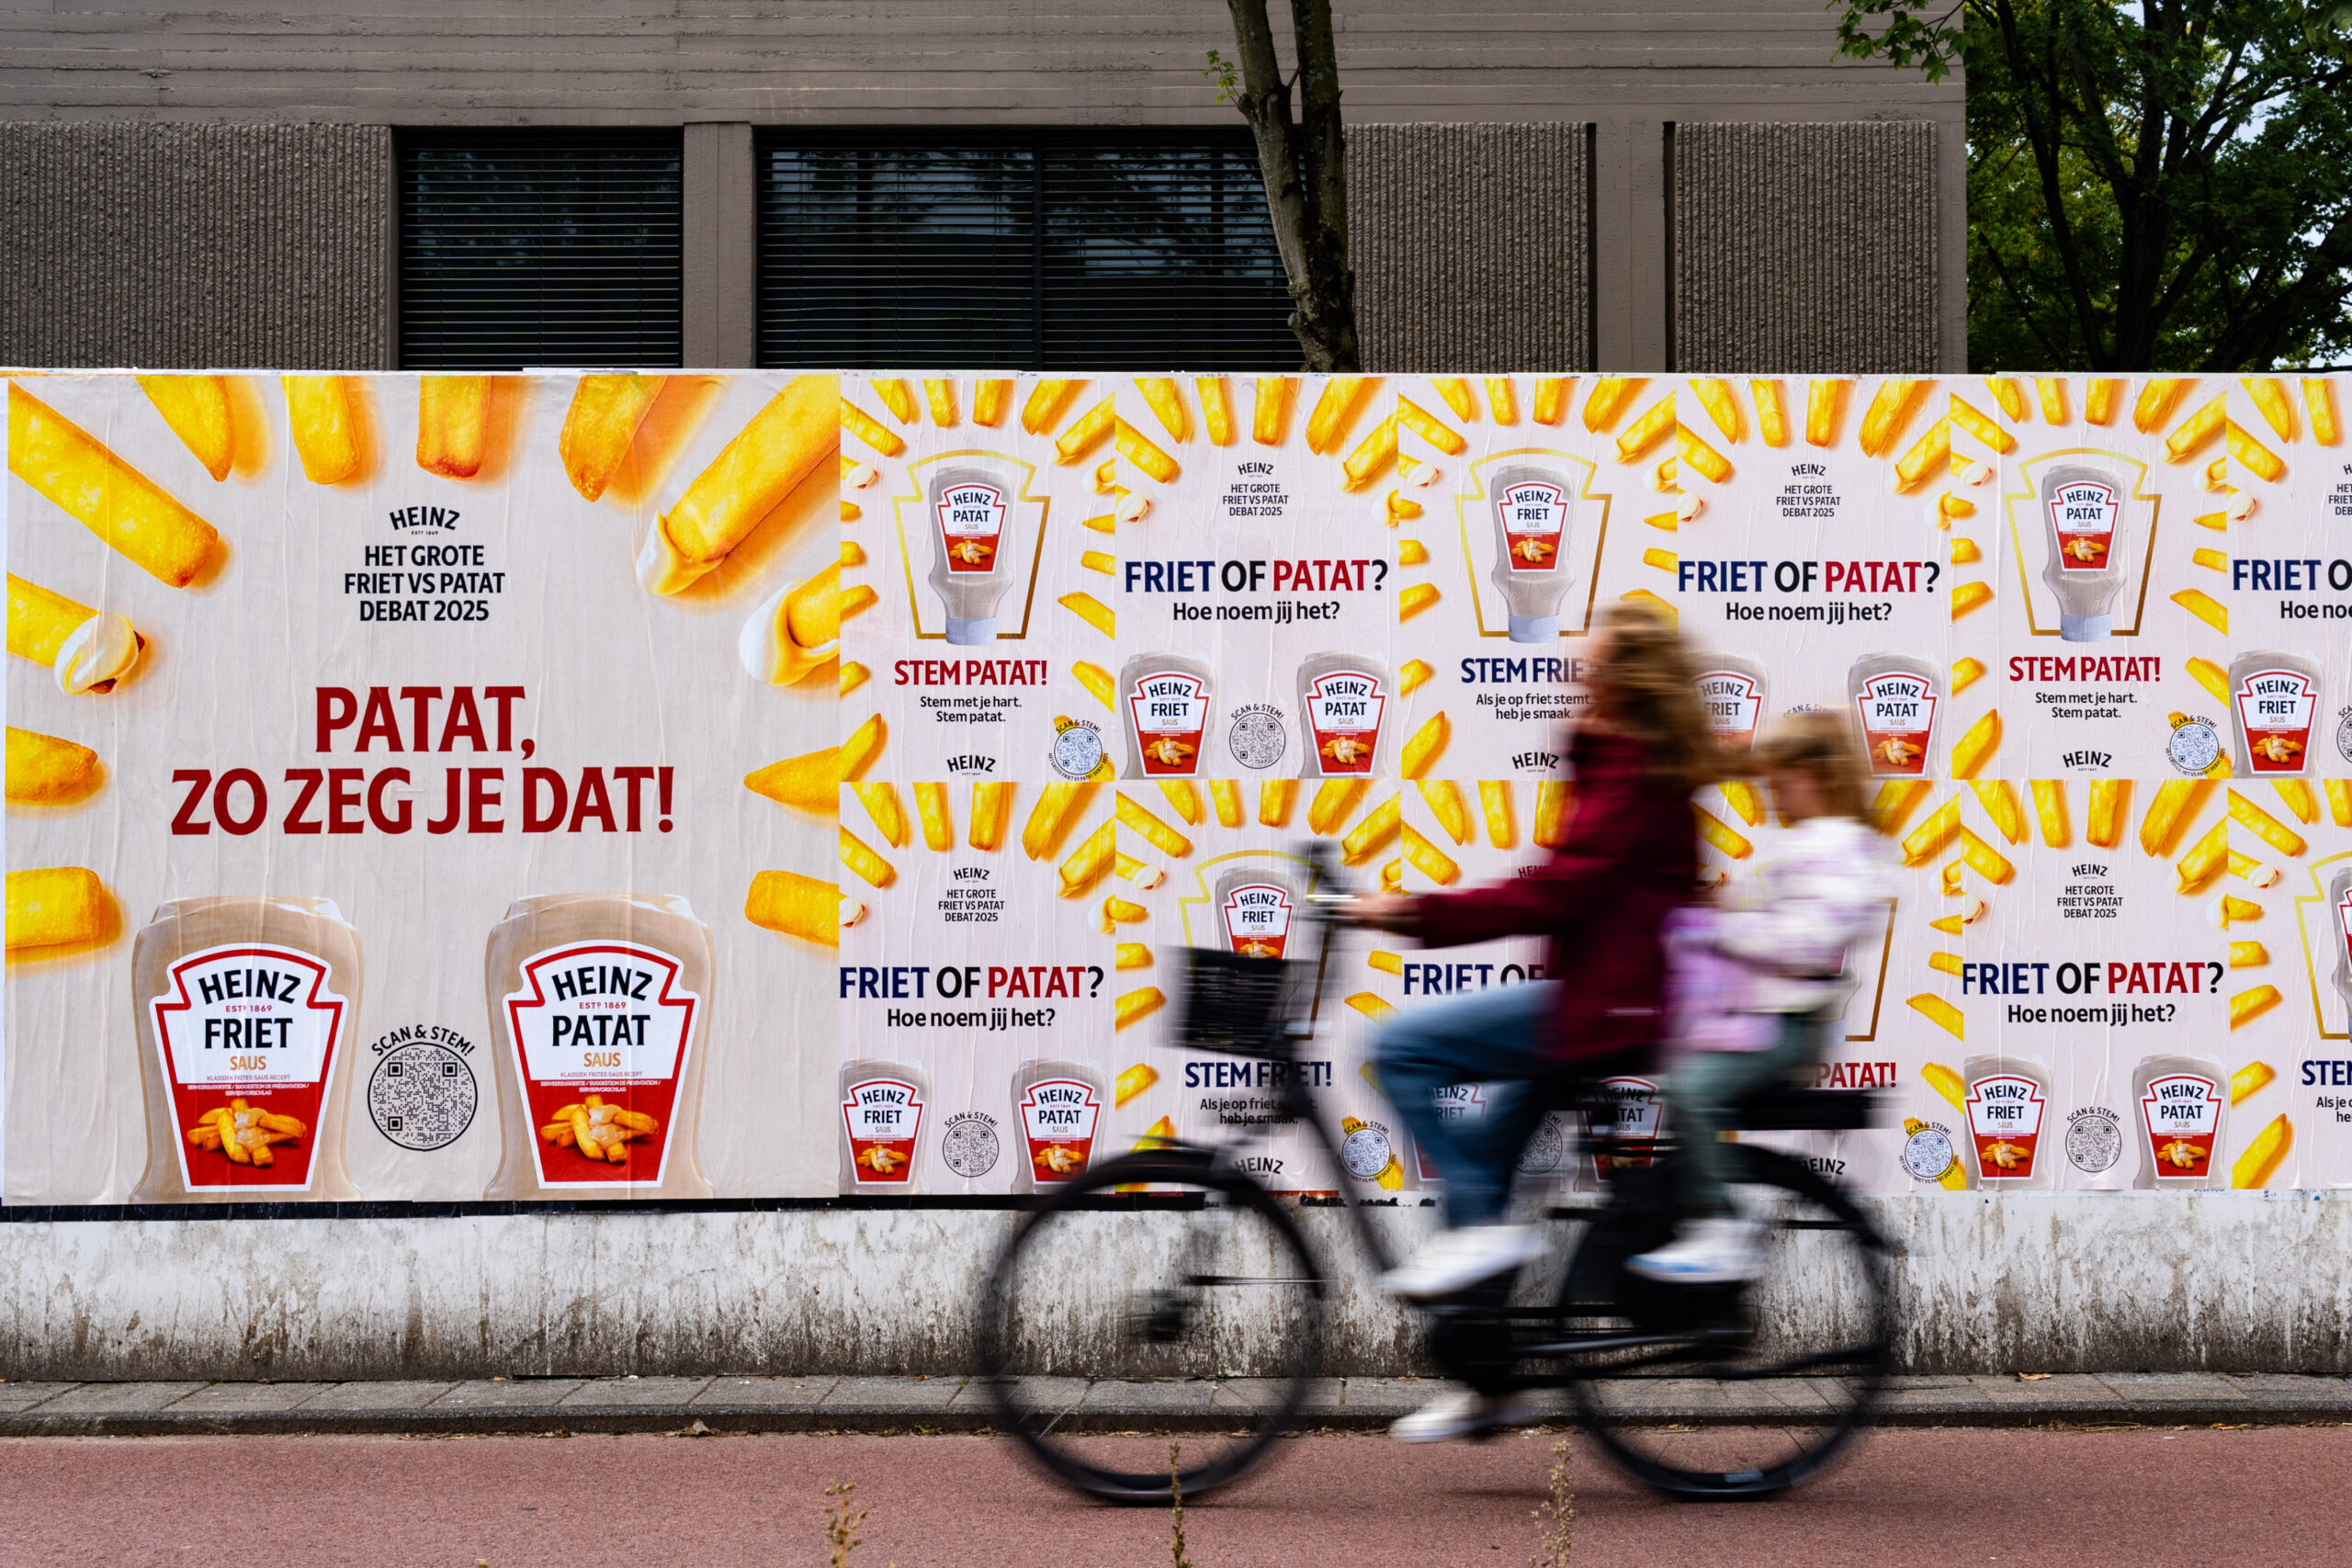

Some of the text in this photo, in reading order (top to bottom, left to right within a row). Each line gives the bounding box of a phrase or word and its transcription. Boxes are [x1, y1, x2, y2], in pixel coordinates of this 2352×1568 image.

[1238, 463, 1273, 475] HEINZ
[1231, 484, 1280, 492] HET GROTE
[954, 492, 990, 505] HEINZ
[1223, 495, 1288, 504] FRIET VS PATAT
[1515, 491, 1552, 503] HEINZ
[2067, 491, 2103, 502] HEINZ
[390, 506, 459, 530] HEINZ
[954, 511, 989, 522] PATAT
[1229, 507, 1282, 515] DEBAT 2025
[1518, 509, 1549, 520] FRIET
[2067, 508, 2102, 519] PATAT
[366, 546, 484, 566] HET GROTE
[1125, 559, 1387, 592] FRIET OF PATAT?
[1679, 561, 1939, 592] FRIET OF PATAT?
[2233, 559, 2322, 590] FRIET
[345, 573, 505, 593] FRIET VS PATAT
[360, 600, 489, 621] DEBAT 2025
[1174, 602, 1340, 624] Hoe noem jij het?
[1726, 602, 1892, 625] Hoe noem jij het?
[2281, 601, 2318, 618] Hoe
[895, 660, 1046, 685] STEM PATAT!
[1462, 658, 1527, 683] STEM
[2009, 657, 2160, 682] STEM PATAT!
[1148, 682, 1192, 697] HEINZ
[1325, 682, 1367, 696] HEINZ
[1877, 682, 1919, 697] HEINZ
[2256, 680, 2299, 694] HEINZ
[921, 696, 1022, 709] Stem met je hart.
[1476, 694, 1493, 705] Als
[1495, 694, 1506, 707] je
[1509, 696, 1522, 706] op
[1525, 694, 1552, 705] friet
[2259, 701, 2296, 714] FRIET
[1151, 704, 1189, 716] FRIET
[1230, 704, 1284, 720] SCAN & STEM!
[1326, 703, 1366, 716] PATAT
[1497, 708, 1574, 721] heb je smaak.
[1877, 704, 1918, 716] PATAT
[316, 686, 535, 760] PATAT,
[936, 711, 1005, 724] Stem patat.
[1056, 719, 1074, 733] SCAN
[1081, 719, 1102, 733] STEM!
[947, 755, 995, 772] HEINZ
[1511, 752, 1559, 769] HEINZ
[2063, 751, 2111, 767] HEINZ
[171, 767, 674, 835] ZO ZEG JE DAT!
[954, 868, 989, 880] HEINZ
[2073, 864, 2108, 876] HEINZ
[947, 889, 996, 898] HET GROTE
[2066, 886, 2114, 895] HET GROTE
[939, 901, 1004, 909] FRIET VS PATAT
[1240, 893, 1277, 906] HEINZ
[2058, 897, 2122, 906] FRIET VS PATAT
[945, 912, 998, 921] DEBAT 2025
[1243, 911, 1274, 922] FRIET
[2064, 908, 2117, 918] DEBAT 2025
[551, 966, 652, 1001] HEINZ
[840, 966, 1103, 998] FRIET OF PATAT?
[1404, 964, 1494, 995] FRIET
[1962, 962, 2223, 994] FRIET OF PATAT?
[198, 969, 300, 1004] HEINZ
[888, 1008, 1055, 1031] Hoe noem jij het?
[2008, 1004, 2175, 1026] Hoe noem jij het?
[205, 1018, 293, 1048] FRIET
[553, 1015, 650, 1046] PATAT
[371, 1024, 475, 1056] SCAN & STEM!
[231, 1055, 266, 1070] SAUS
[584, 1053, 620, 1066] SAUS
[1185, 1063, 1251, 1088] STEM
[1815, 1062, 1896, 1089] PATAT!
[862, 1089, 905, 1104] HEINZ
[1039, 1089, 1081, 1104] HEINZ
[1984, 1085, 2027, 1100] HEINZ
[2161, 1085, 2203, 1100] HEINZ
[1201, 1098, 1276, 1112] Als je op friet
[1987, 1106, 2024, 1119] FRIET
[2161, 1105, 2203, 1119] PATAT
[865, 1111, 901, 1123] FRIET
[944, 1112, 965, 1128] SCAN
[974, 1111, 998, 1128] STEM!
[1039, 1111, 1081, 1123] PATAT
[2066, 1108, 2087, 1123] SCAN
[2097, 1107, 2120, 1122] STEM!
